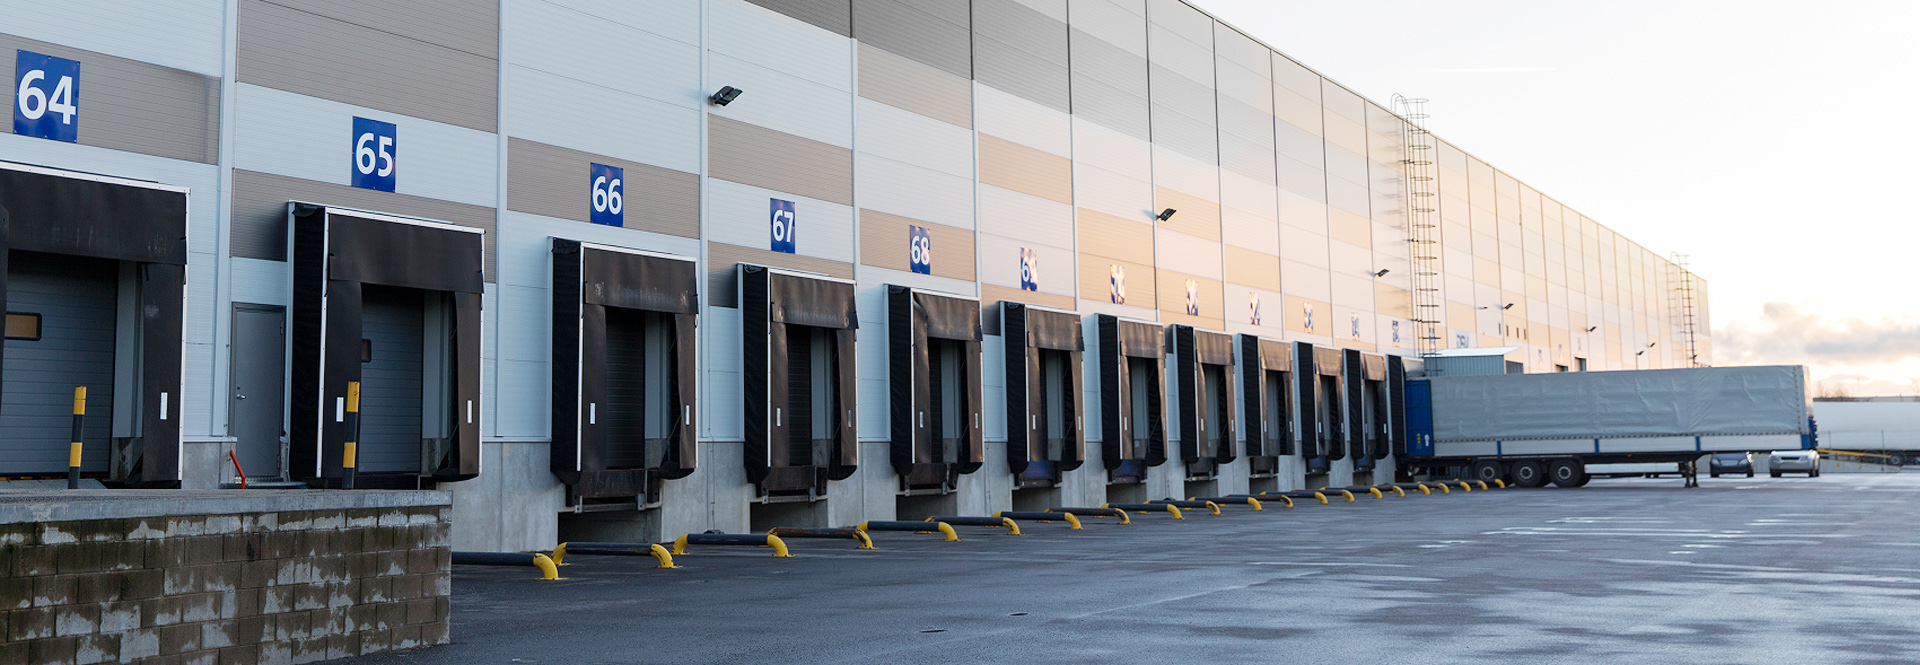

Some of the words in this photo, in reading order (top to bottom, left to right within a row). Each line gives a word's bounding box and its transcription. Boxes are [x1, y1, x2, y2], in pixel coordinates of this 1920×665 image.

[18, 70, 76, 125] 64
[356, 133, 393, 176] 65
[592, 176, 621, 214] 66
[773, 210, 795, 242] 67
[911, 235, 930, 265] 68
[1022, 256, 1036, 283] 69
